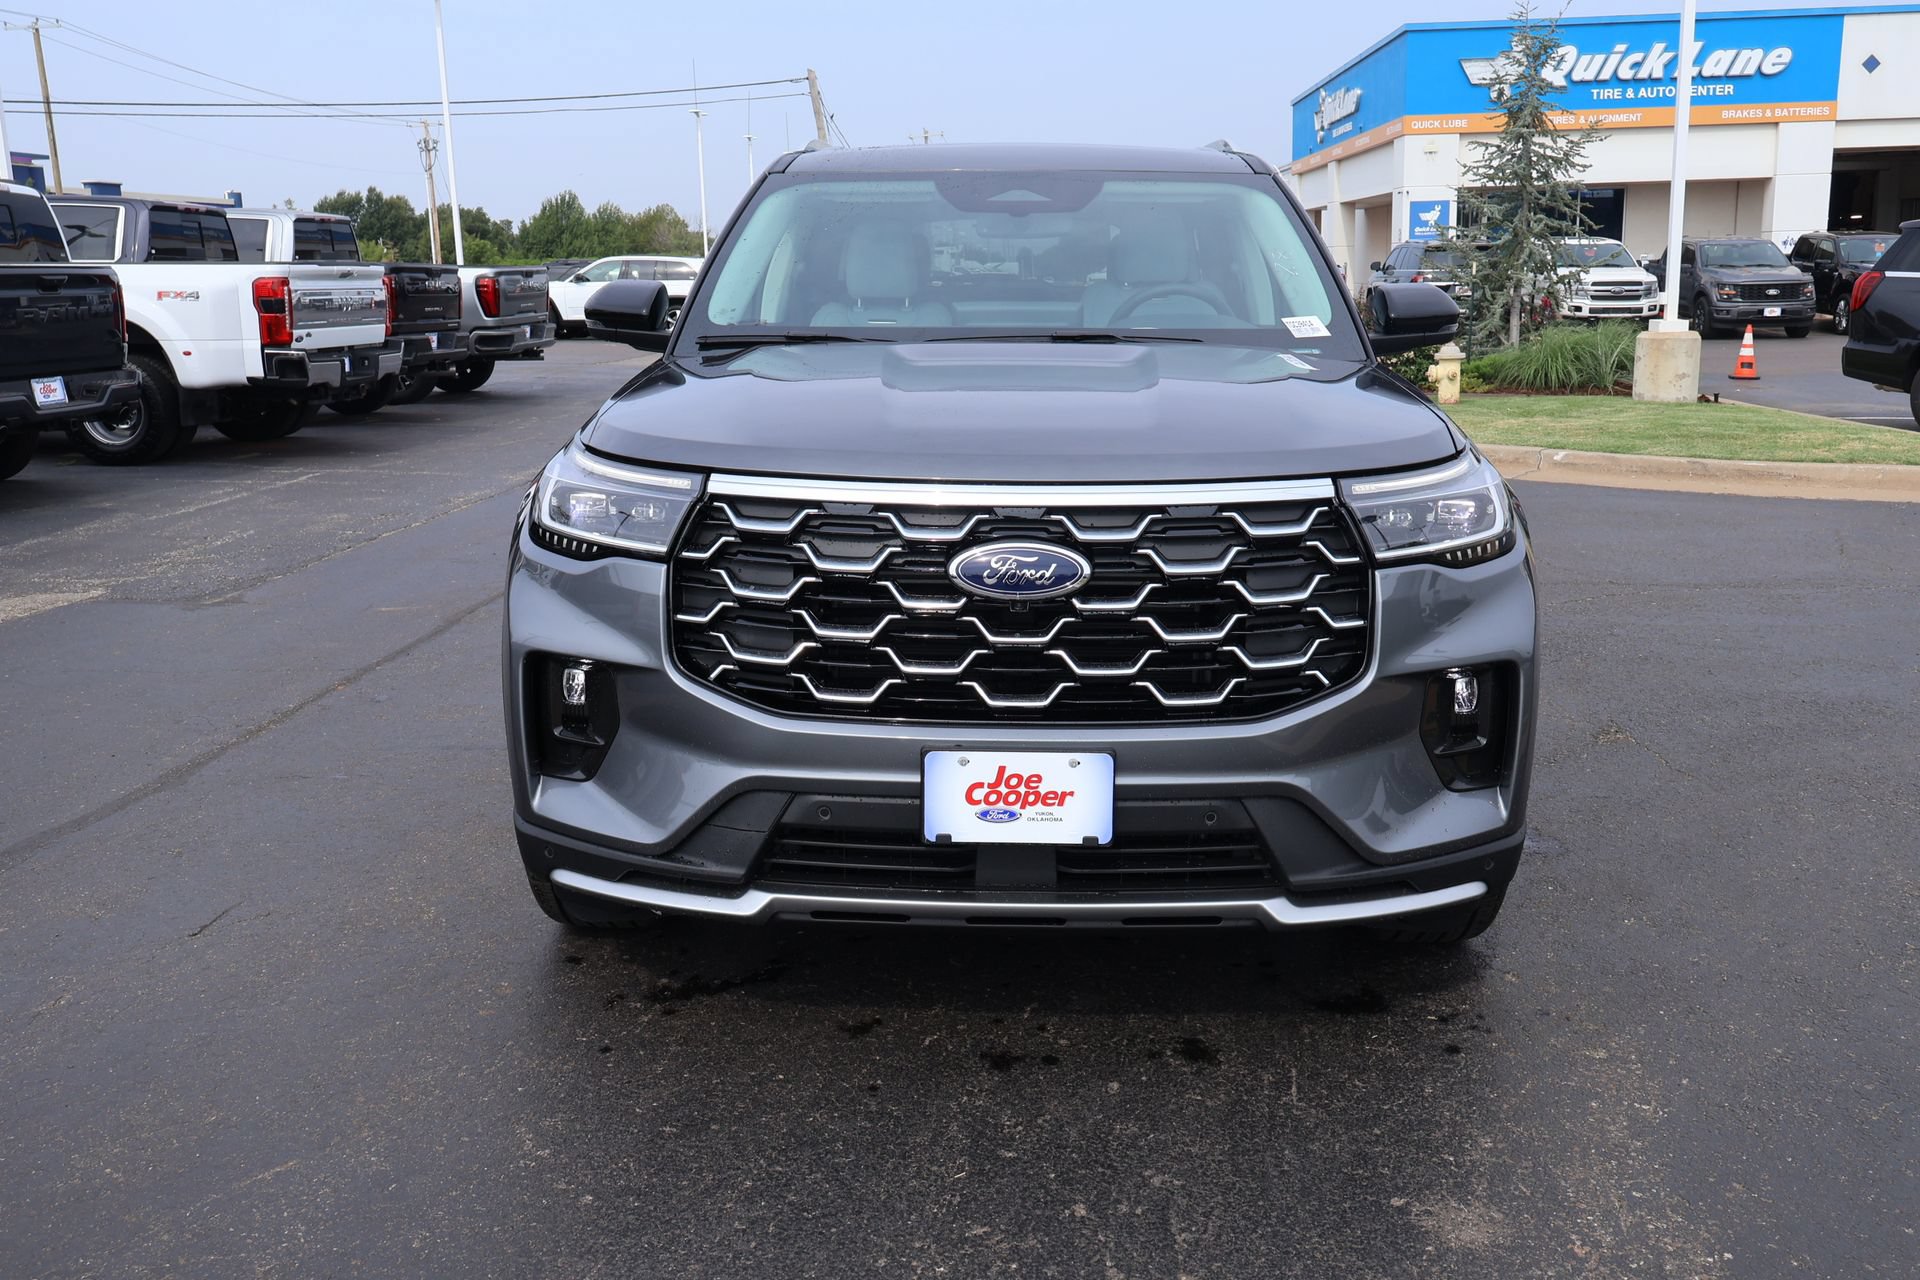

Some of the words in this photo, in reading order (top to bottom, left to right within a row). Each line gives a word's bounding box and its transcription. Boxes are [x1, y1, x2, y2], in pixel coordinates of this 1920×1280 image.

[1541, 41, 1677, 89] Quick
[1591, 88, 1622, 99] TIRE
[1626, 88, 1635, 98] &
[1638, 86, 1675, 98] AUTO
[1690, 84, 1734, 96] ENTER
[1549, 115, 1575, 125] TIRES
[1579, 115, 1586, 124] &
[1588, 113, 1642, 123] ALIGNMENT
[1722, 109, 1762, 119] BRAKES
[1765, 109, 1772, 117] &
[1775, 107, 1830, 117] BATTERIES
[1411, 120, 1441, 129] QUICK
[1443, 119, 1468, 128] LUBE
[157, 290, 200, 301] FX4
[983, 554, 1057, 585] Ford
[987, 765, 1043, 790] Joe
[965, 782, 1075, 810] Cooper
[987, 810, 1010, 820] Ford
